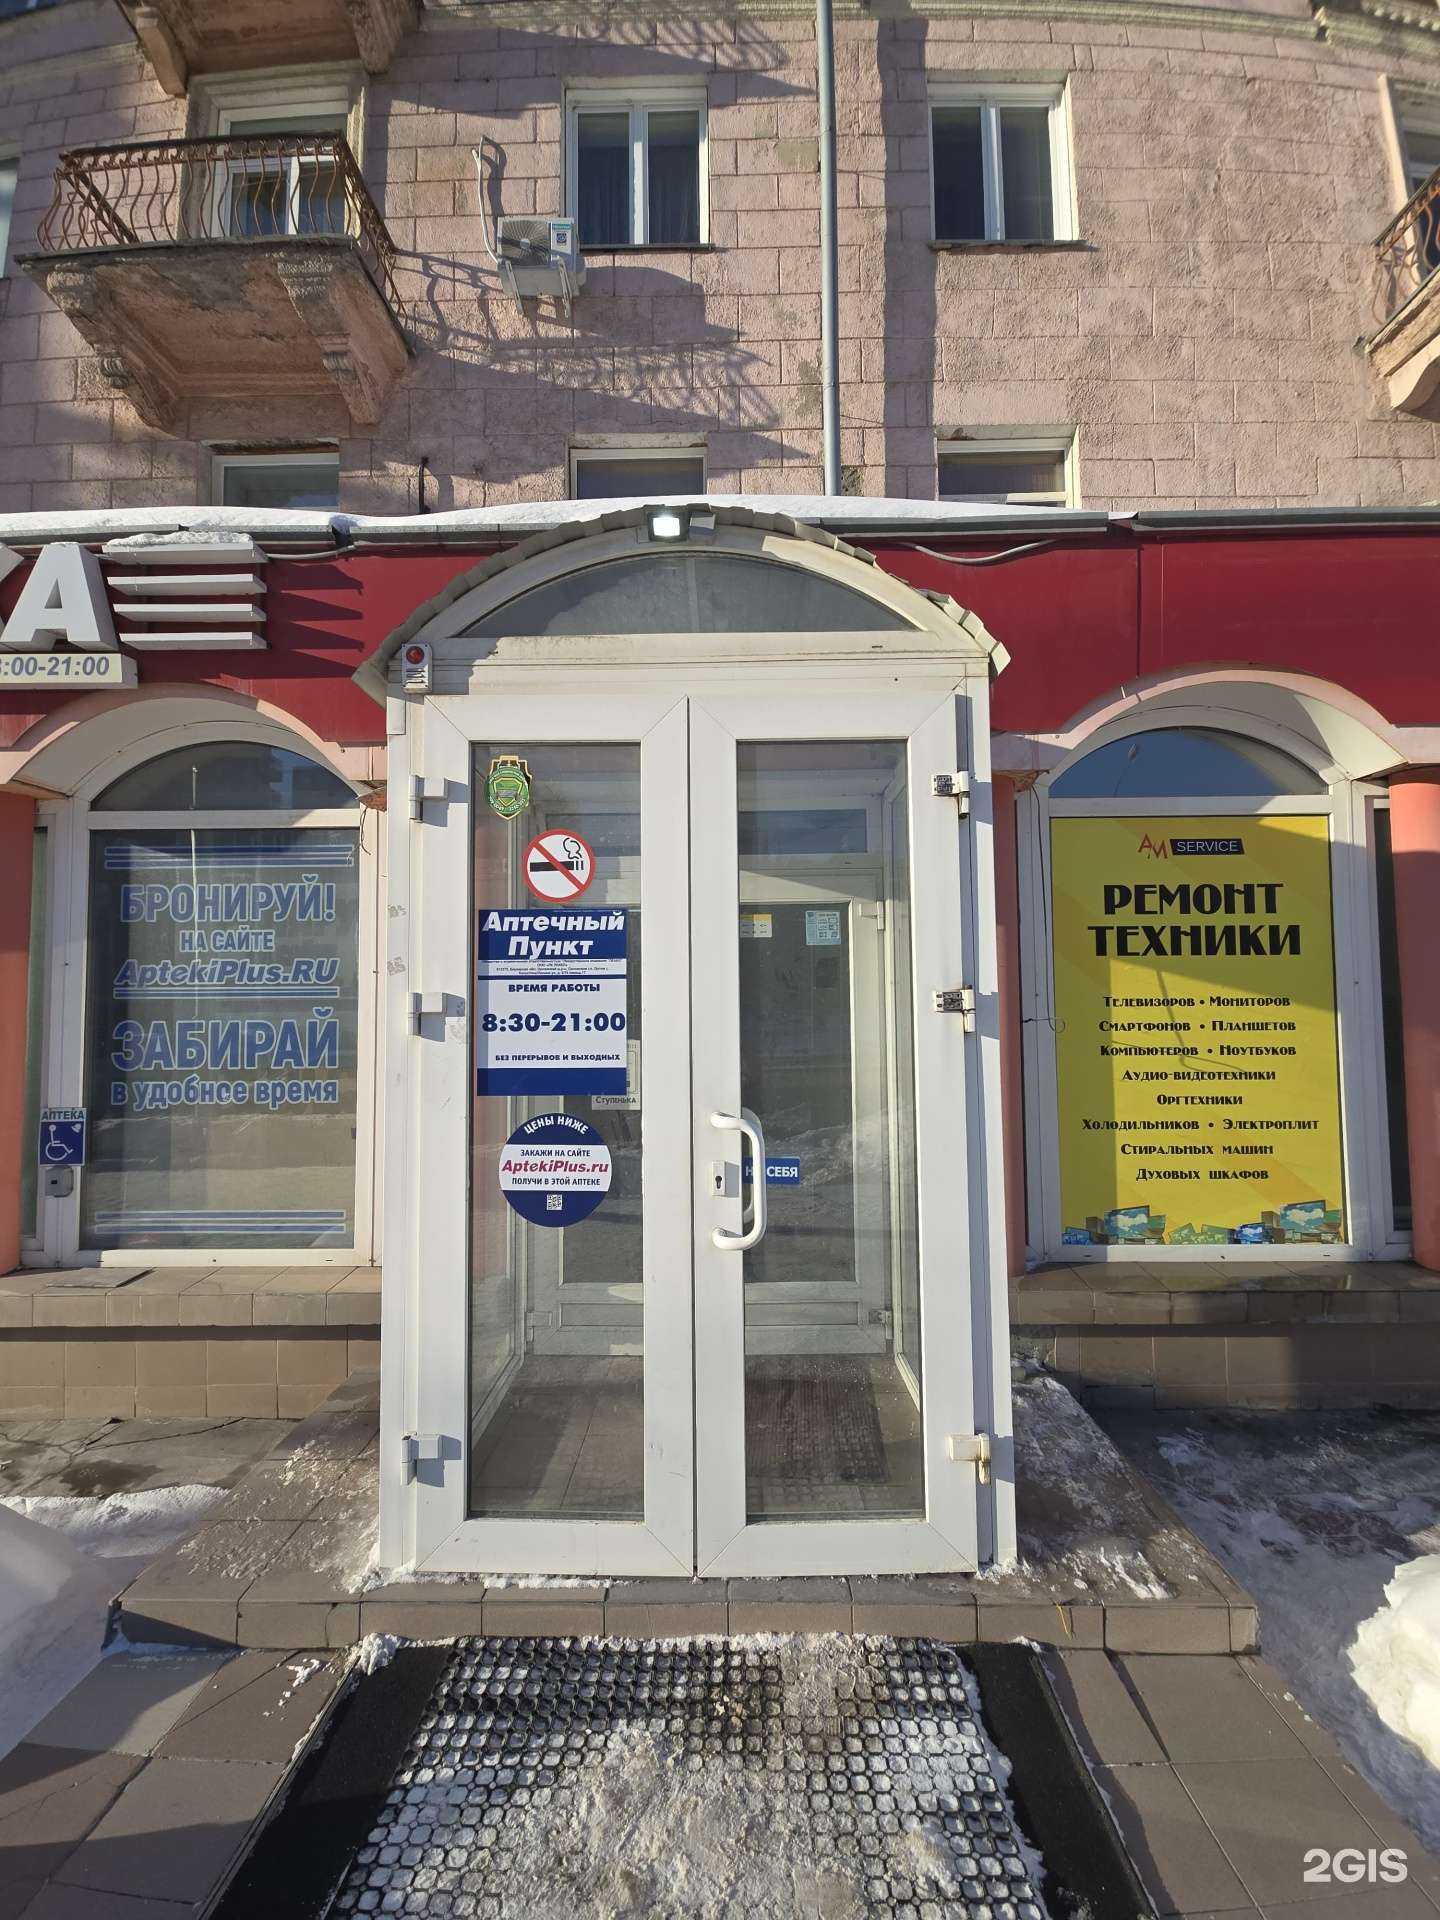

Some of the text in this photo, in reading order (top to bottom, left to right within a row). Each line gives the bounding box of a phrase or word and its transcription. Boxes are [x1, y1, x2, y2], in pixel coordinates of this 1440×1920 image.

[0, 541, 118, 651] А
[0, 656, 110, 676] :00-21:00
[1177, 841, 1238, 852] SERVICE
[120, 873, 336, 923] БРОНИРУЙ!
[1103, 884, 1284, 915] РЕМОНТ
[482, 911, 624, 932] Аптечный
[180, 926, 275, 952] НА САЙТЕ
[508, 936, 593, 959] Пункт
[1088, 924, 1301, 957] ТЕХНИКИ
[113, 958, 340, 987] AptekiPlus.RU
[509, 983, 600, 993] ВРЕМЯ РАБОТЫ
[482, 1012, 626, 1032] 8:30-21:00
[111, 1006, 339, 1070] ЗАБИРАЙ
[571, 1053, 620, 1061] ВЫХОДНЫХ
[112, 1075, 337, 1110] в удобнее время
[42, 1110, 84, 1120] АПТЕКА
[523, 1116, 589, 1135] ЦЕНЫ НИЖЕ
[520, 1148, 591, 1157] ЗАКАЖИ НА САЙТЕ
[502, 1159, 609, 1174] AptekiPlus.ru
[766, 1166, 798, 1177] СЕБЯ
[512, 1177, 544, 1186] ПОЛУЧИ
[551, 1176, 570, 1186] ЭТОЙ
[572, 1178, 600, 1186] АПТЕКЕ
